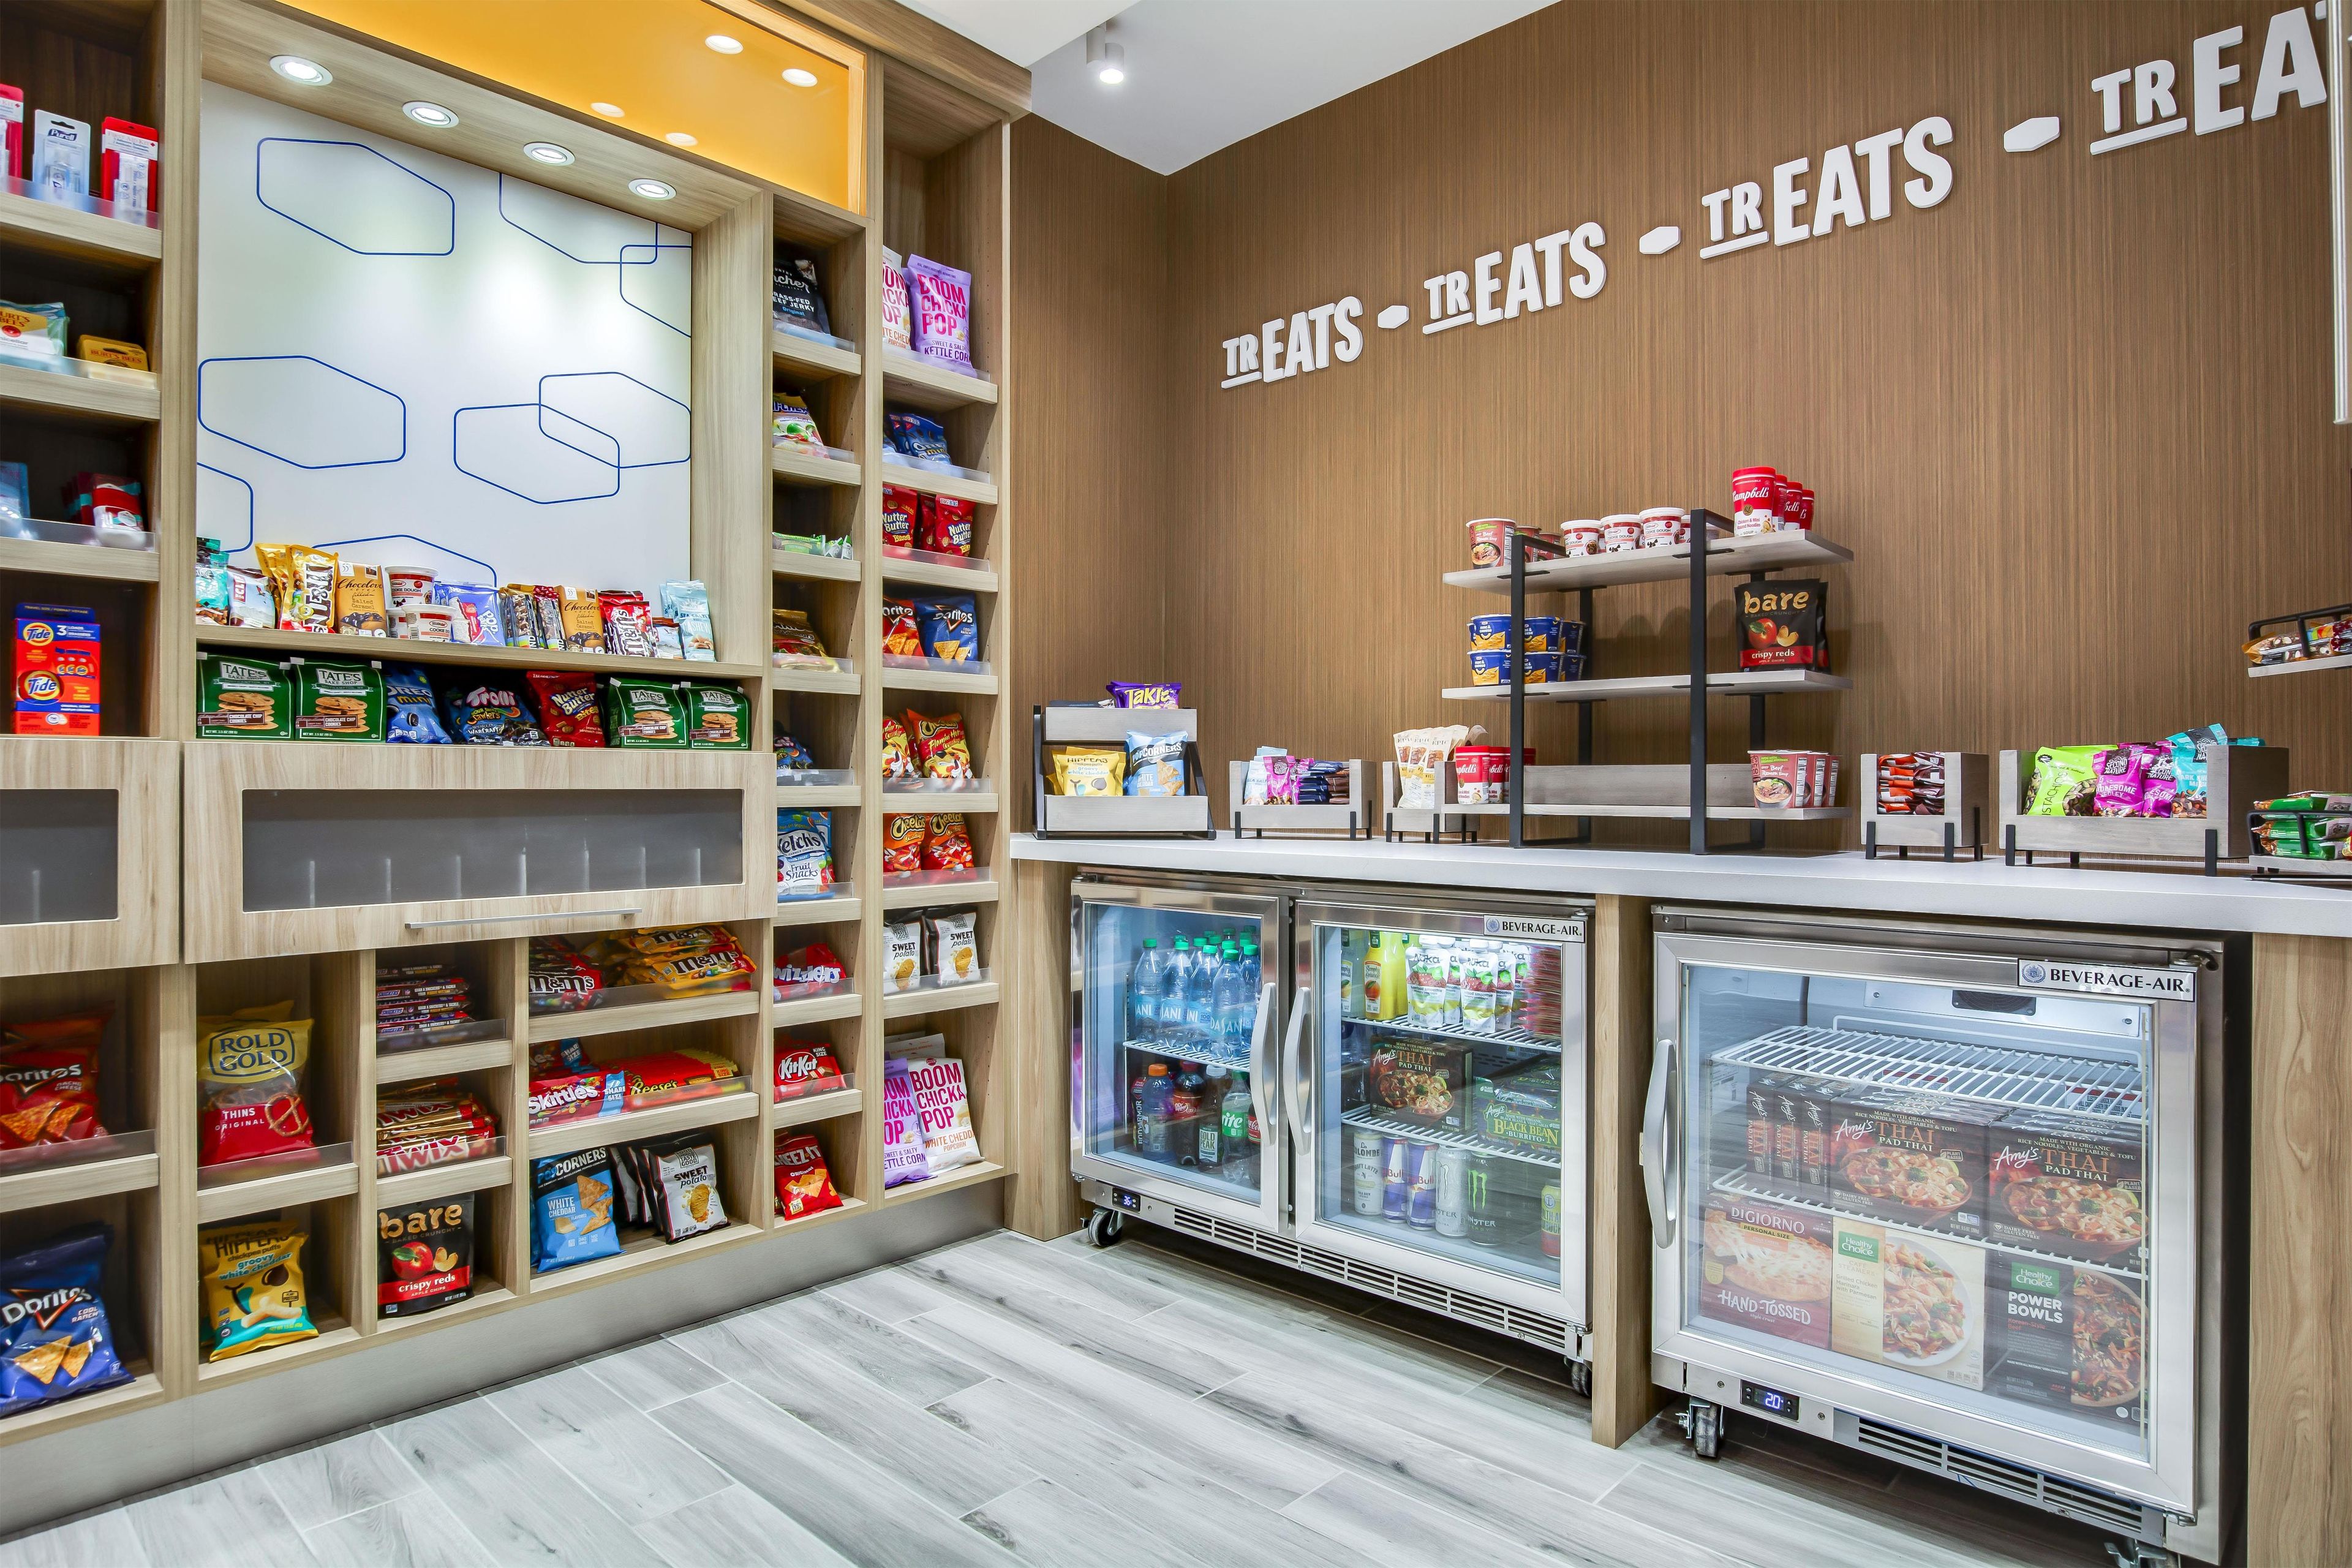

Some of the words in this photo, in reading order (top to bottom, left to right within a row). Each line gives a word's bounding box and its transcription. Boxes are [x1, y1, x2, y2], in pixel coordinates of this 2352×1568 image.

[2091, 1, 2328, 137] TREA
[1702, 116, 1953, 246] TREATS
[1423, 222, 1606, 326] TREATS
[917, 273, 966, 305] BOOM
[790, 302, 814, 312] JERKY
[922, 295, 966, 320] CHICKA
[922, 314, 957, 336] POP
[1222, 296, 1363, 383] TREATS
[925, 347, 952, 358] KETTLE
[1732, 486, 1770, 502] Campbell's
[884, 522, 910, 532] Butter
[1744, 590, 1809, 614] bare
[933, 609, 973, 623] Doritos
[27, 628, 50, 641] Tide
[57, 625, 67, 636] 3
[1752, 650, 1773, 660] crispy
[1776, 648, 1795, 657] reds
[222, 663, 267, 677] TATE'S
[318, 670, 361, 681] TATE'S
[29, 678, 56, 694] Tide
[397, 695, 431, 704] mini
[466, 686, 516, 707] Trolli
[551, 687, 588, 707] Nutter
[631, 690, 663, 701] TATE'S
[701, 692, 731, 701] TATE'S
[562, 693, 595, 715] Butter
[575, 706, 599, 722] Bites
[1133, 742, 1183, 763] POPCORNERS
[2106, 757, 2127, 769] SECOND
[891, 815, 925, 839] Cheetos
[903, 832, 923, 842] Crunchy
[785, 869, 818, 881] Snacks
[791, 862, 810, 872] Fruit
[950, 930, 973, 941] SWEET
[1502, 921, 1580, 936] BEVERAGE-AIR
[892, 942, 915, 952] SWEET
[1413, 953, 1439, 964] Noka
[2050, 969, 2184, 993] BEVERAGE-AIR
[219, 1032, 285, 1054] ROLD
[219, 1049, 288, 1071] GOLD
[1373, 1049, 1398, 1067] Amy's
[1397, 1050, 1433, 1067] THAI
[910, 1061, 962, 1093] BOOM
[605, 1085, 626, 1095] SHARE
[630, 1076, 678, 1097] Reese's
[529, 1083, 598, 1112] Skittles
[916, 1085, 966, 1109] CHICKA
[1749, 1091, 1768, 1118] Amy's
[222, 1107, 255, 1120] THINS
[1485, 1105, 1506, 1119] Amy's
[1777, 1095, 1796, 1122] Amy's
[1804, 1100, 1823, 1128] Amy's
[214, 1119, 265, 1131] ORIGINAL
[920, 1106, 954, 1133] POP
[1898, 1119, 1934, 1129] VEGETABLES
[1493, 1118, 1528, 1134] BLACK
[1529, 1125, 1559, 1145] BEAN
[1508, 1131, 1543, 1142] BURRITO
[1834, 1118, 1874, 1142] Amy's
[1875, 1121, 1934, 1144] THAI
[924, 1136, 948, 1149] WHITE
[943, 1141, 967, 1152] POPCORN
[1200, 1140, 1215, 1150] PEAK
[1879, 1136, 1901, 1146] PAD
[1904, 1140, 1933, 1152] THAI
[2079, 1143, 2111, 1152] ORGANIC
[903, 1147, 918, 1156] SALTY
[906, 1152, 925, 1167] CORN
[1993, 1145, 2040, 1170] Amy's
[2068, 1147, 2108, 1156] VEGETABLES
[537, 1147, 607, 1185] POPCORNERS
[681, 1158, 698, 1167] GOOD
[2041, 1148, 2109, 1174] THAI
[674, 1165, 708, 1182] SWEET
[680, 1173, 707, 1189] potato
[2045, 1166, 2071, 1175] PAD
[2074, 1170, 2108, 1182] THAI
[547, 1196, 575, 1212] WHITE
[549, 1206, 576, 1219] CHEDDAR
[1731, 1207, 1804, 1234] DIGIORNO
[379, 1204, 462, 1239] bare
[392, 1234, 421, 1244] BAKED
[421, 1227, 456, 1238] CRUNCHY
[1743, 1225, 1776, 1237] PERSONAL
[2003, 1229, 2026, 1238] GLUTEN
[1841, 1243, 1874, 1257] Choice
[1845, 1237, 1872, 1250] Healthy
[219, 1268, 249, 1280] white
[251, 1253, 292, 1272] cheddar
[237, 1254, 274, 1270] groovy
[1838, 1263, 1875, 1276] STEAMERS
[2015, 1275, 2053, 1288] Choice
[2020, 1268, 2052, 1281] Healthy
[399, 1279, 432, 1293] crispy
[434, 1273, 456, 1286] reds
[1836, 1280, 1860, 1290] Marinara
[1855, 1279, 1878, 1289] Chicken
[1849, 1288, 1877, 1300] Parmesan
[2008, 1291, 2063, 1311] POWER
[2, 1287, 92, 1327] Doritos
[77, 1306, 99, 1317] COOL
[1717, 1289, 1812, 1325] HAND-TOSSED
[2007, 1303, 2064, 1324] BOWLS
[72, 1312, 99, 1323] RANCH
